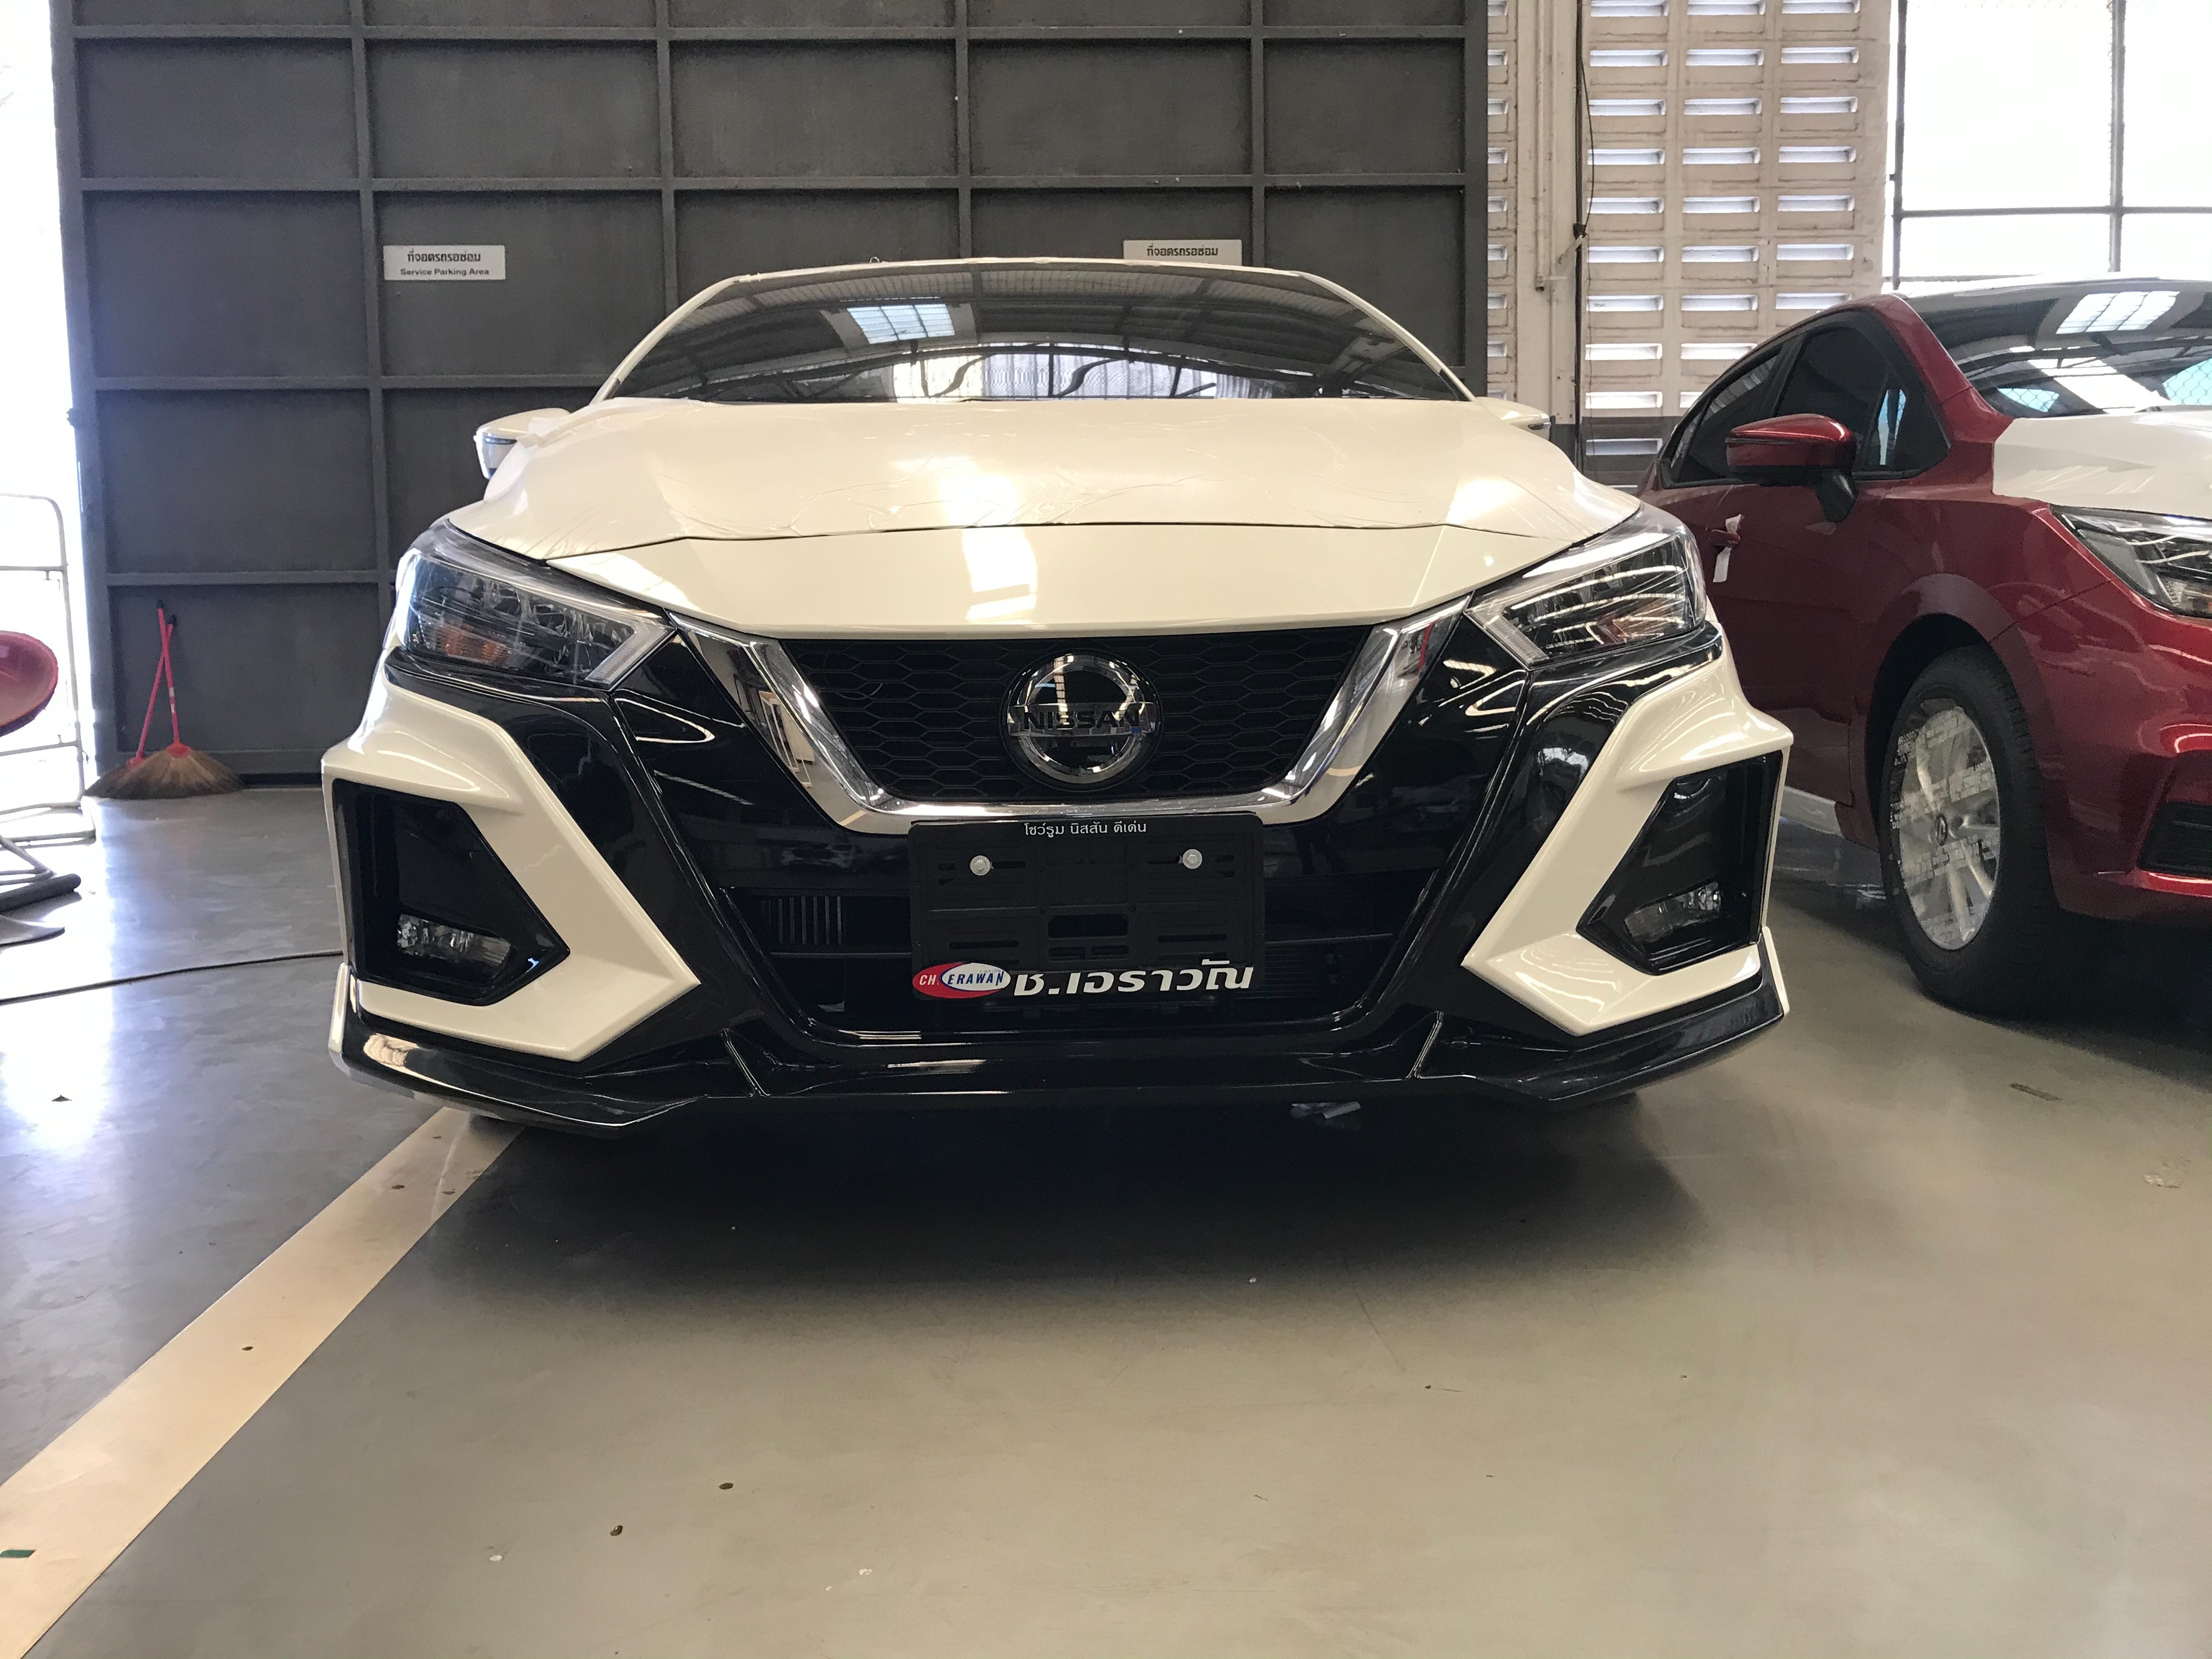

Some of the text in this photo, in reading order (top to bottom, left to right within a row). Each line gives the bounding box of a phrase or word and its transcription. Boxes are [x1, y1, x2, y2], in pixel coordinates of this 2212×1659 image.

[1023, 710, 1139, 729] NISSAN
[1024, 820, 1147, 838] โชว์รูม นิสสัน ดีเด่น
[947, 971, 1004, 986] ERAWAN
[1014, 959, 1254, 996] ช.เอราวัณ
